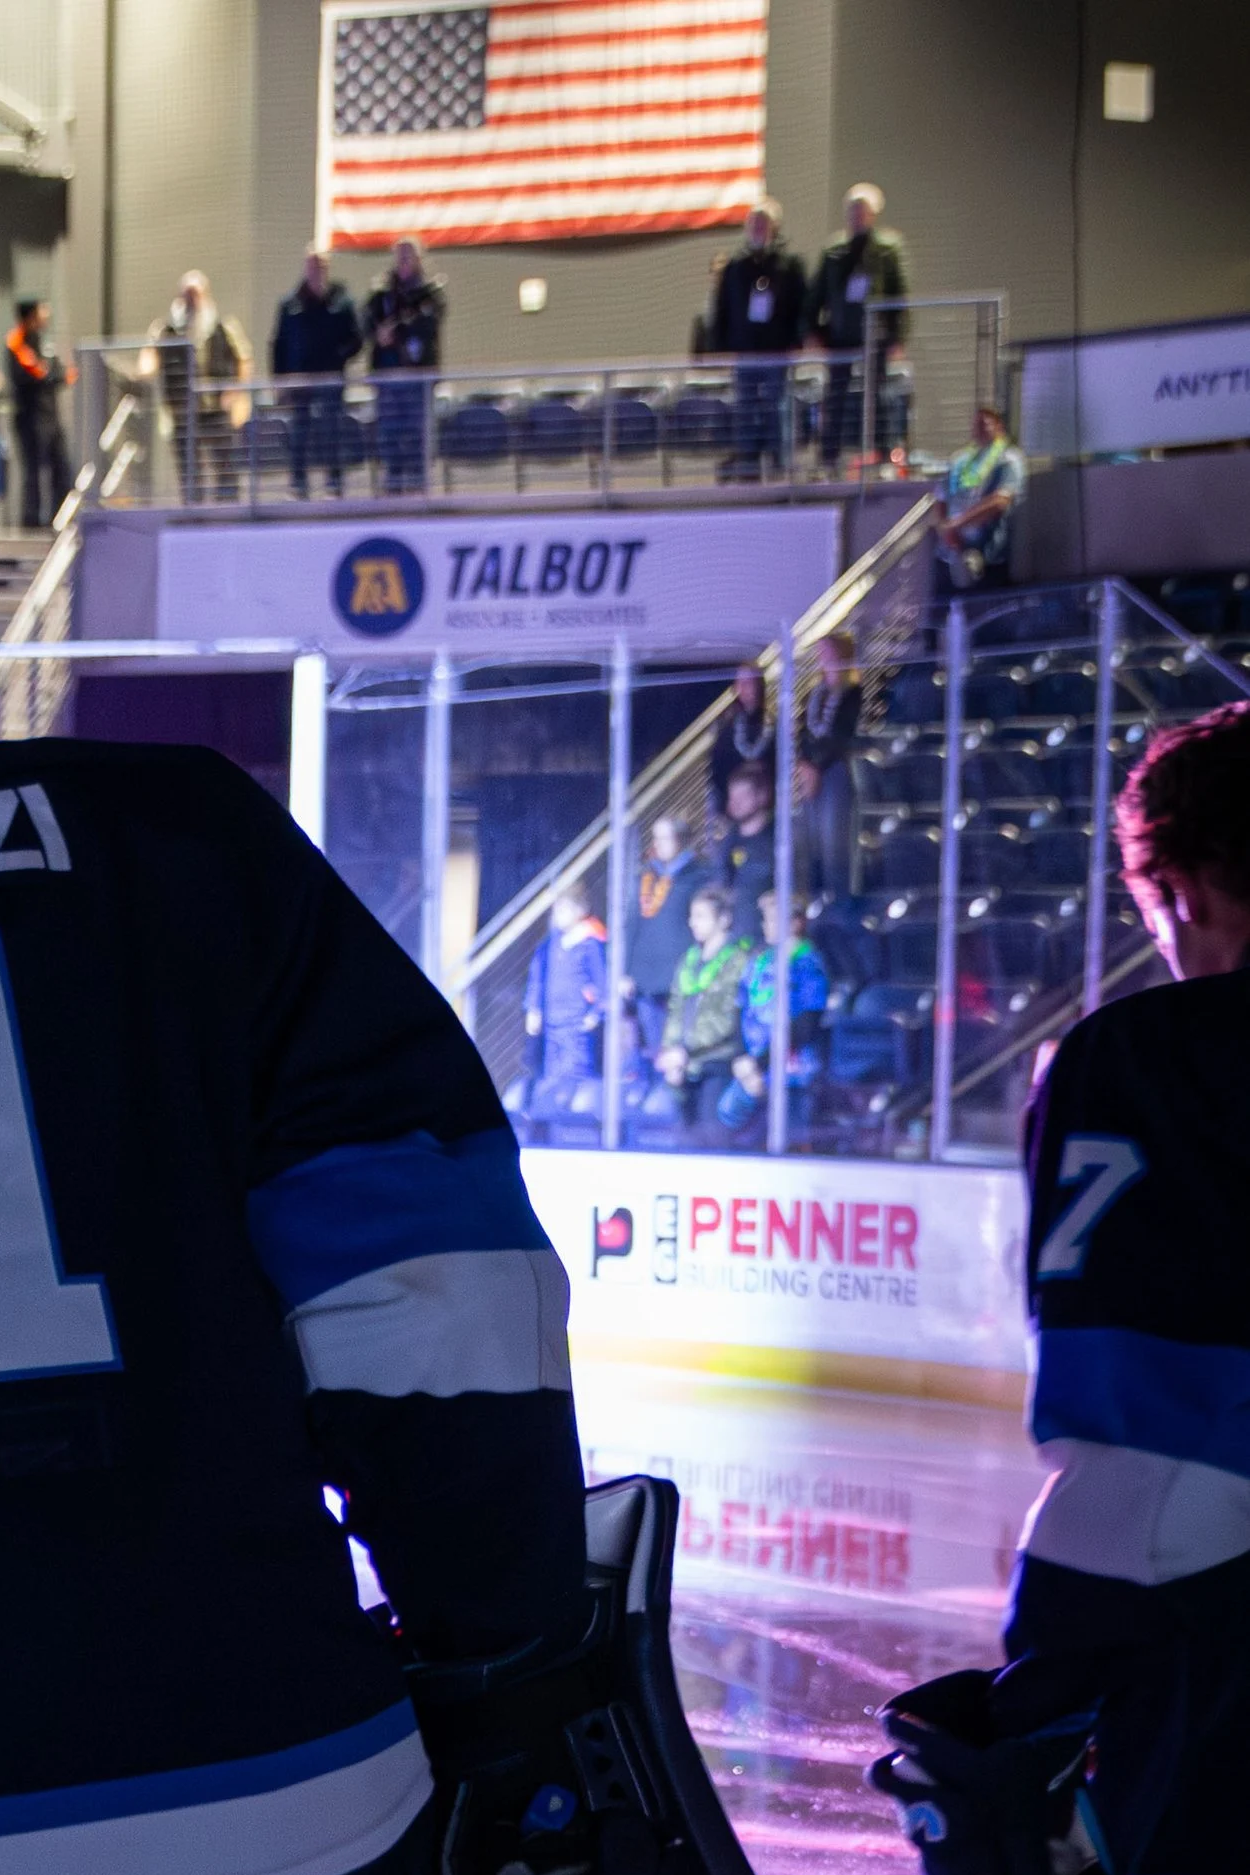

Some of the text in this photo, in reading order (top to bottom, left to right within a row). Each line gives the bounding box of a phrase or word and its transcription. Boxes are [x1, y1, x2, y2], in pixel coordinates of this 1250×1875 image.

[446, 538, 646, 601] TALBOT
[689, 1196, 918, 1271] PENNER
[1037, 1133, 1148, 1281] 7
[683, 1263, 918, 1307] BUILDING CENTRE
